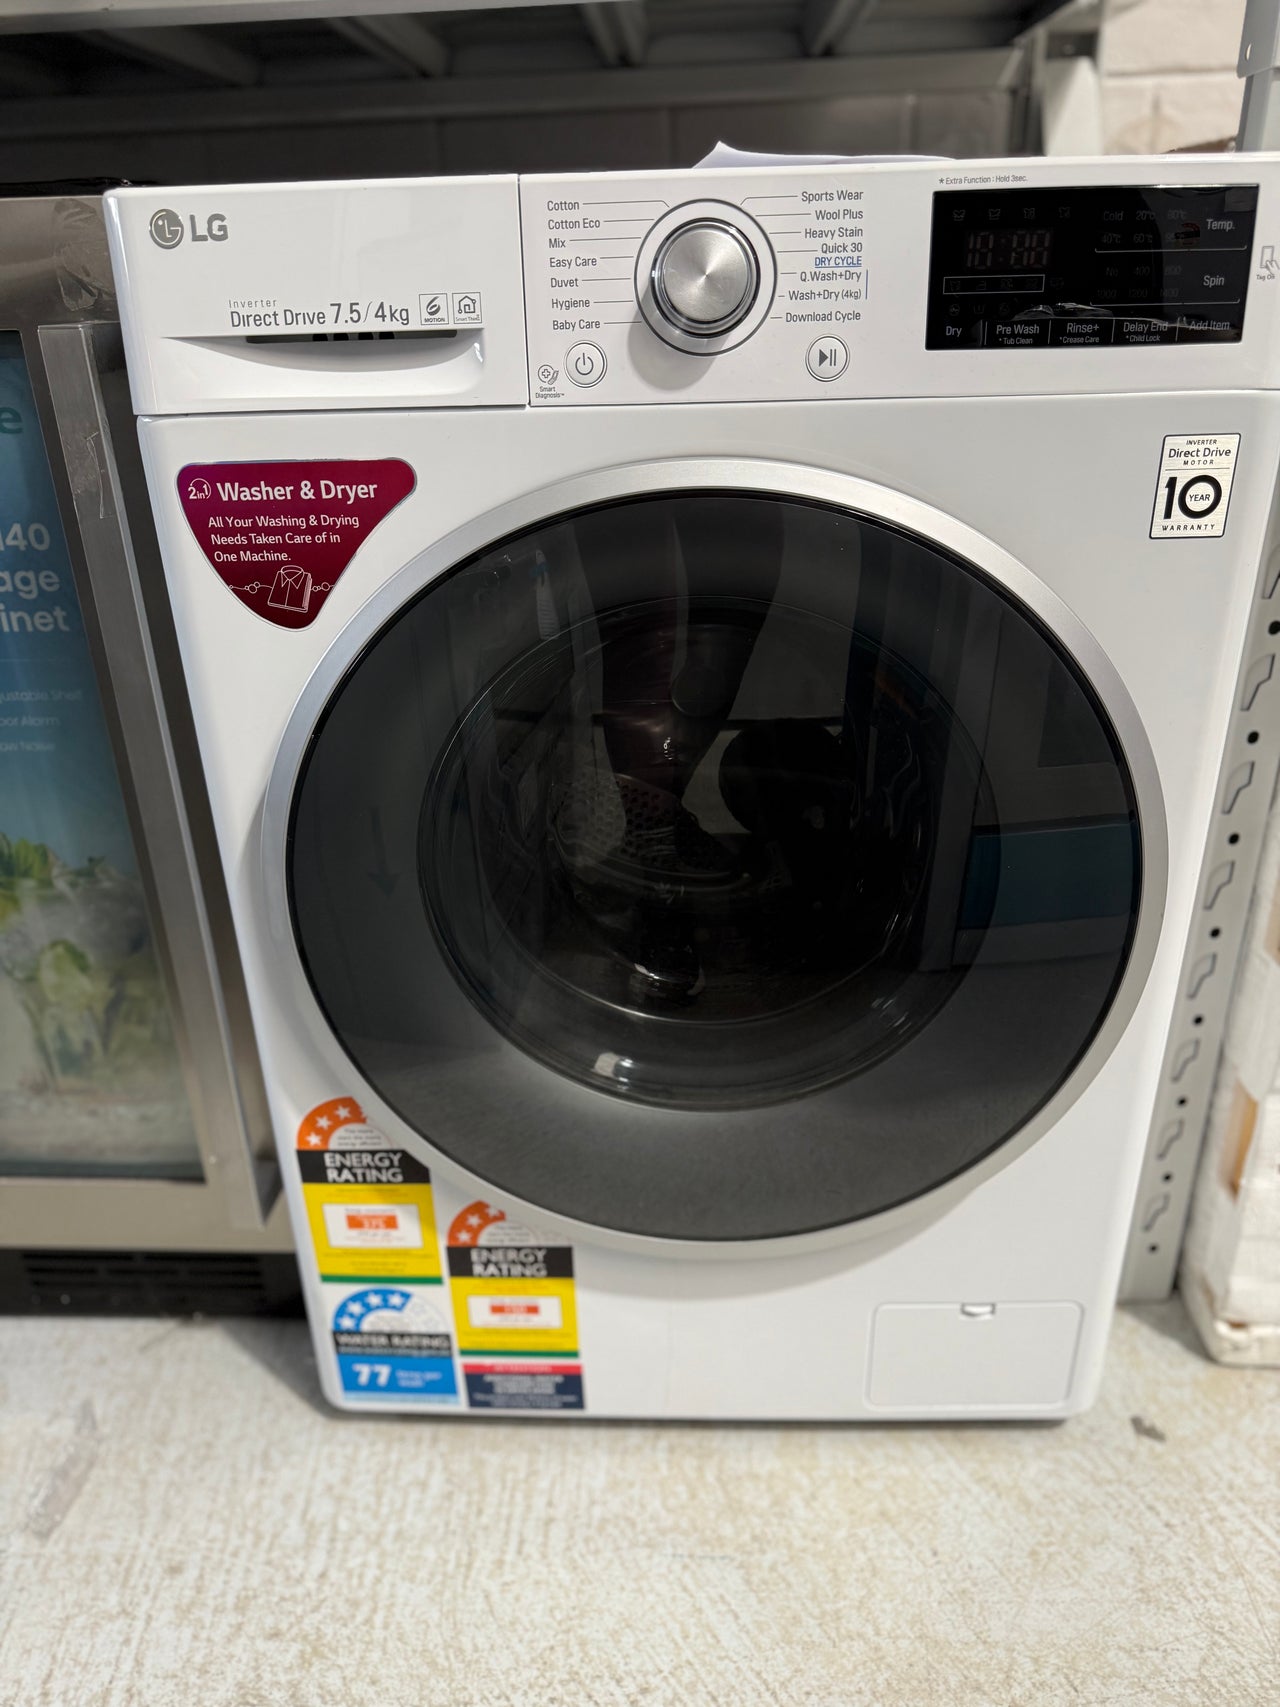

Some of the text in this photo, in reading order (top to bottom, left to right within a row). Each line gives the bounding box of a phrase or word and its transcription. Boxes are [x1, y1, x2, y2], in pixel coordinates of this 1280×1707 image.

[964, 175, 991, 183] Function
[801, 189, 864, 203] Sports Wear
[547, 200, 580, 211] Cotton
[815, 209, 864, 220] Wool Plus
[189, 213, 229, 242] LG
[548, 218, 601, 230] Cotton Eco
[1206, 217, 1236, 232] Temp.
[804, 226, 864, 240] Heavy Stain
[548, 238, 567, 249] Mix
[821, 242, 863, 254] Quick 30
[549, 256, 598, 269] Easy Care
[814, 256, 862, 266] DRY CYCLE
[550, 277, 579, 288] Duvet
[800, 270, 862, 283] Q.Wash+Dry
[1203, 275, 1225, 288] Spin
[788, 289, 862, 301] Wash+Dry (4kg)
[228, 299, 277, 309] Inverter
[551, 298, 590, 310] Hygiene
[230, 311, 280, 328] Direct
[284, 308, 326, 325] Drive
[785, 310, 862, 323] Download Cycle
[552, 318, 601, 331] Baby Care
[996, 324, 1040, 335] Pre Wash
[1067, 322, 1100, 333] Rinse+
[1123, 320, 1168, 333] Delay End
[1189, 320, 1231, 331] Add Item
[946, 326, 962, 337] Dry
[1016, 336, 1033, 344] Clean
[1085, 335, 1100, 344] Care
[1146, 334, 1161, 342] Lock
[1168, 447, 1231, 458] Direct Drive
[217, 481, 294, 501] Washer
[300, 480, 315, 499] &
[320, 480, 378, 504] Dryer
[1164, 475, 1222, 519] 10
[1189, 493, 1211, 502] YEAR
[208, 514, 360, 529] All Your Washing & Drying
[1162, 523, 1215, 531] WARRANTY
[211, 531, 341, 545] Needs Taken Care of in
[214, 550, 292, 562] One Machine.
[323, 1152, 402, 1168] ENERGY
[326, 1168, 403, 1183] RATING
[470, 1248, 547, 1263] ENERGY
[473, 1263, 547, 1277] RATING
[337, 1333, 390, 1347] WATER
[391, 1335, 450, 1349] RATING
[352, 1363, 391, 1387] 77
